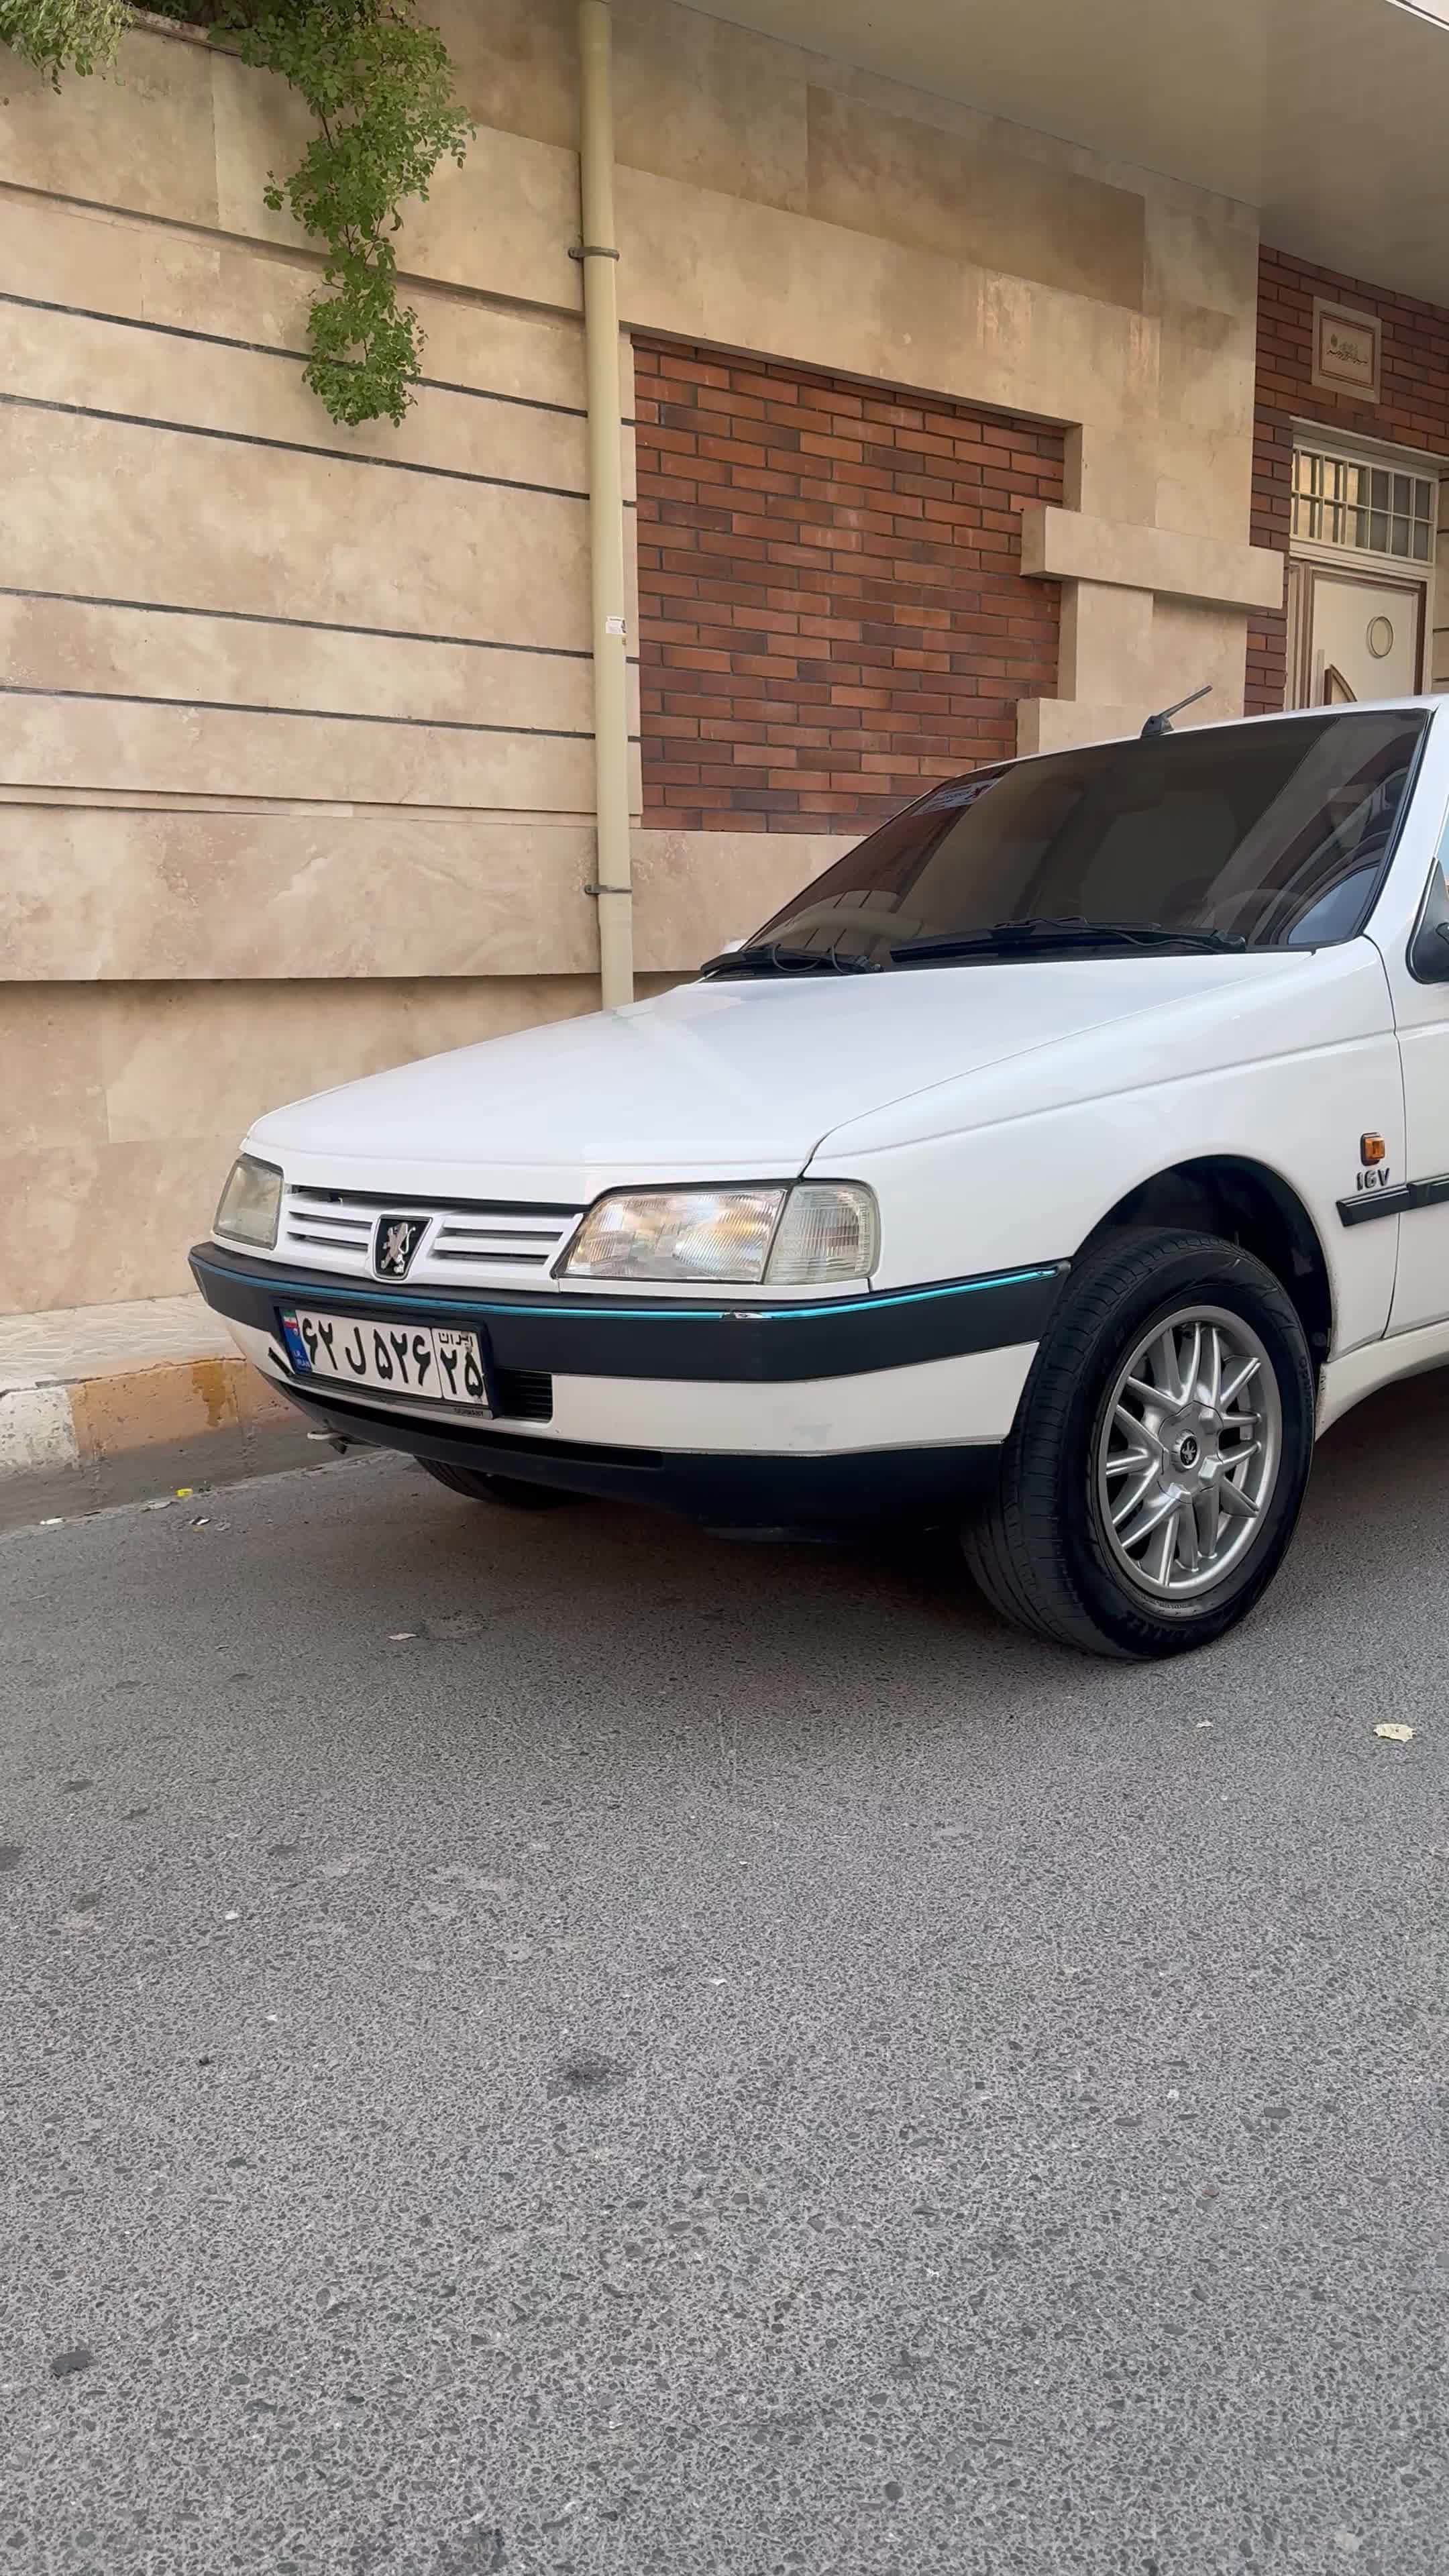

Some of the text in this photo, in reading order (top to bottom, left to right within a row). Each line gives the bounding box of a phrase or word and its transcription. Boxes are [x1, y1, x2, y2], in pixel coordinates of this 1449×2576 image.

[303, 1318, 431, 1387] ۶۲ ل ۵۲۶
[438, 1332, 474, 1347] ایران
[440, 1348, 484, 1397] ۲۵
